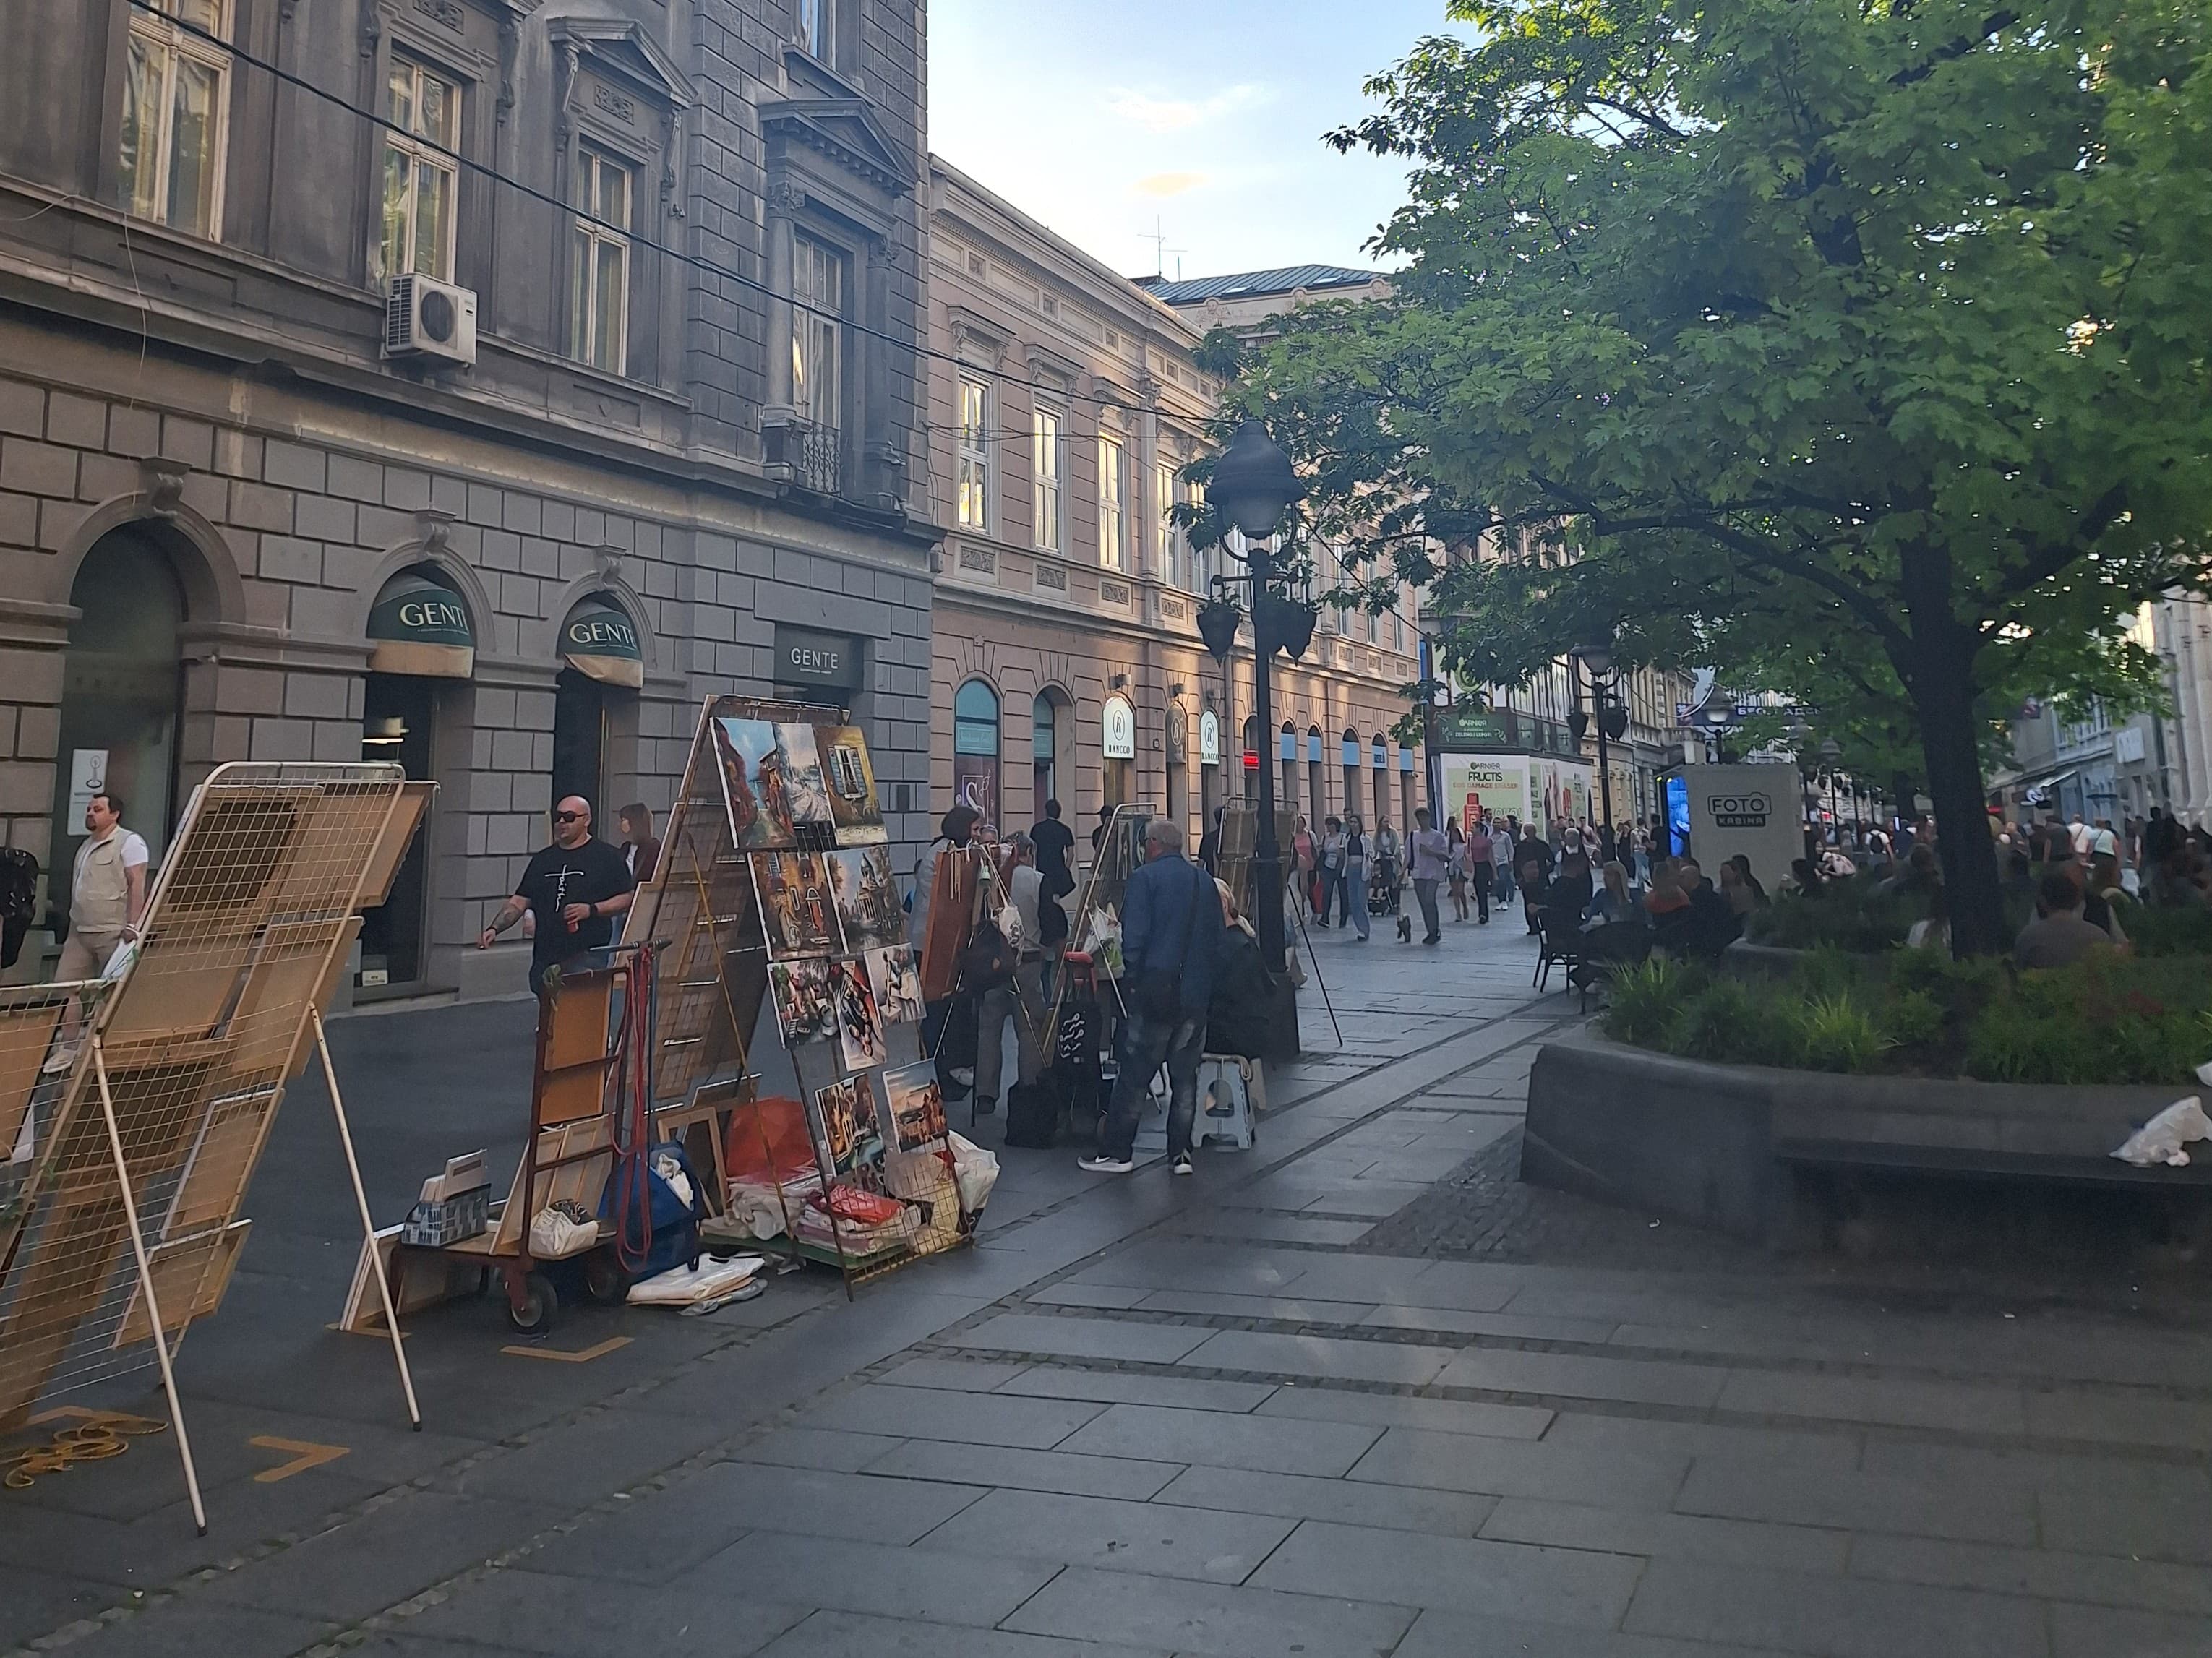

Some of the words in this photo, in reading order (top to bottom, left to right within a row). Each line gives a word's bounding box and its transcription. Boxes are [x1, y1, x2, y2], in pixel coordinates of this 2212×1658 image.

[791, 647, 838, 669] GENTE
[1468, 772, 1503, 781] FRUCTIS
[1712, 798, 1765, 812] FOTO
[1718, 817, 1764, 825] KABINA
